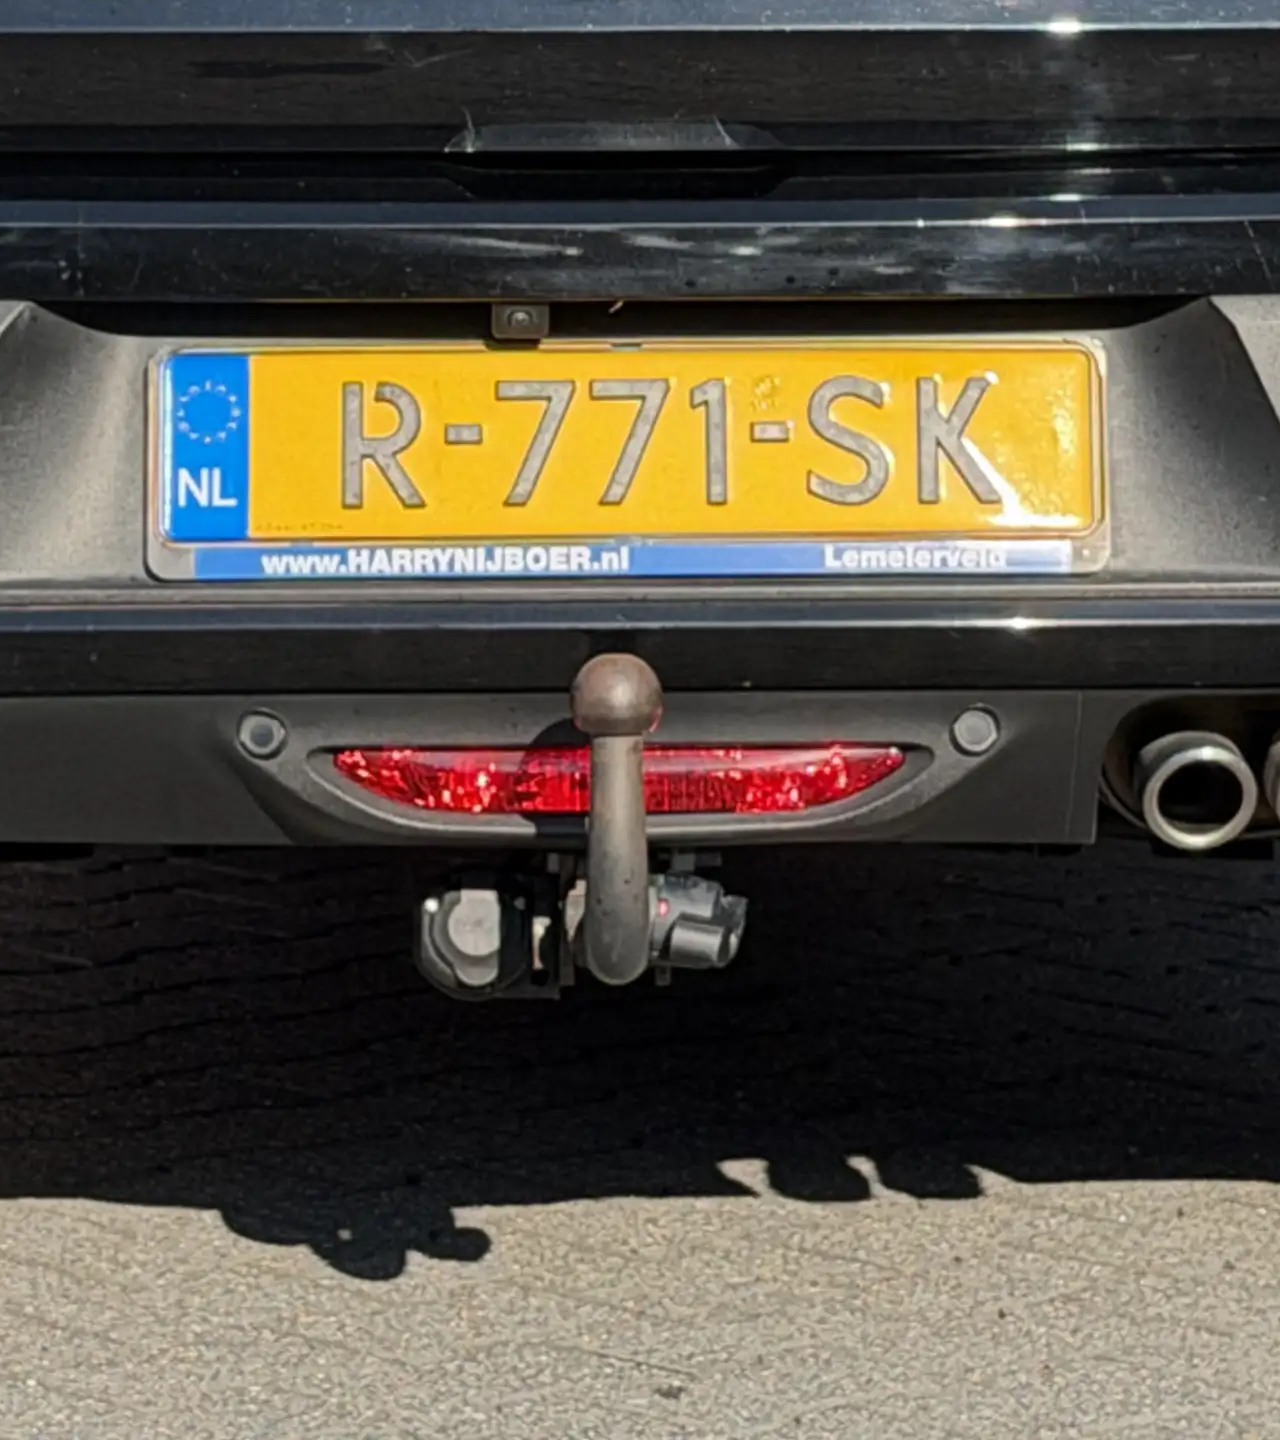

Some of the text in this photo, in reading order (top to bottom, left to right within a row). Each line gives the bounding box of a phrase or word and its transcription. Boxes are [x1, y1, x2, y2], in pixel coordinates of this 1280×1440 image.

[341, 374, 1003, 509] R-771-SK
[177, 466, 239, 508] NL
[261, 545, 629, 574] www.HARRYNIJBOER.nl
